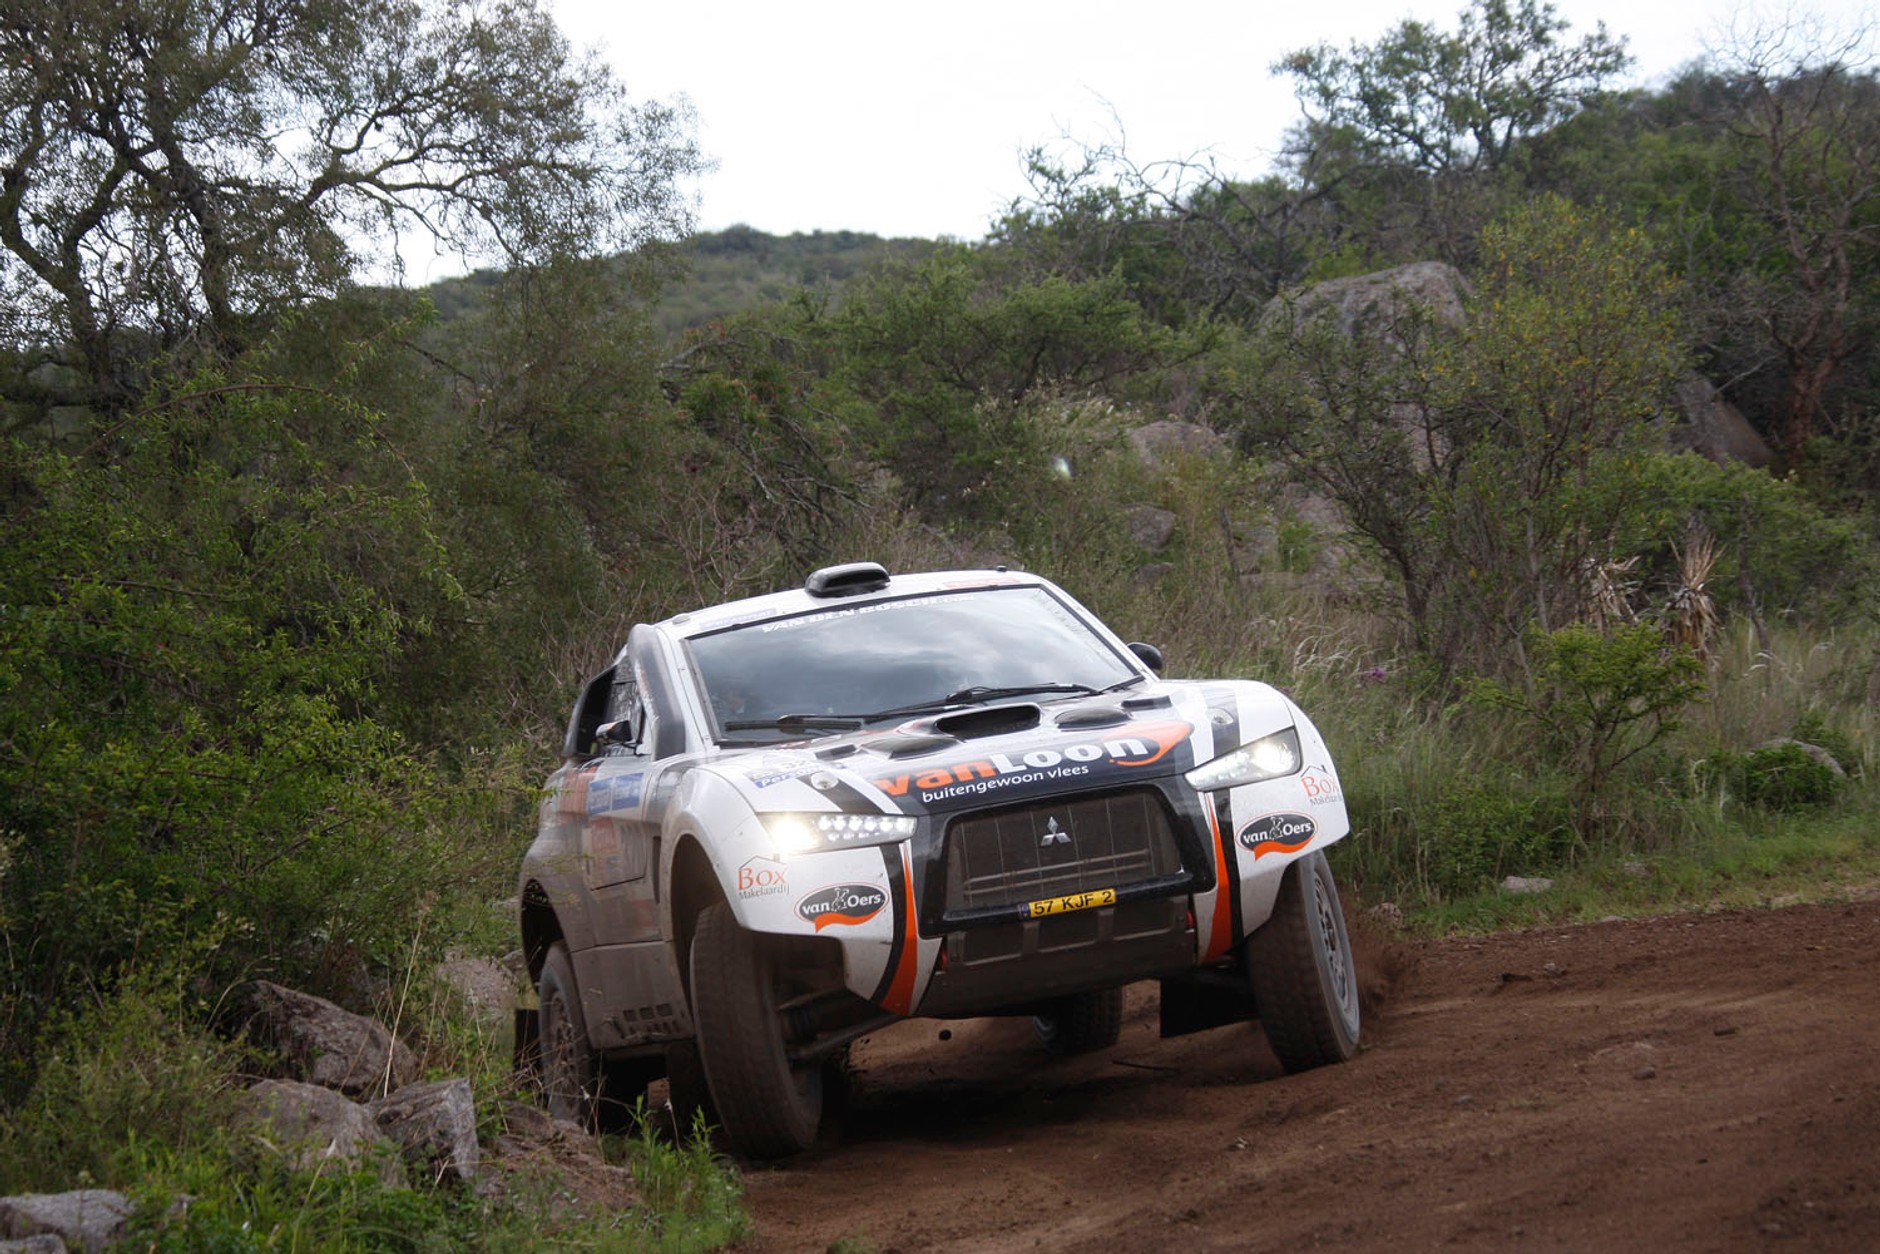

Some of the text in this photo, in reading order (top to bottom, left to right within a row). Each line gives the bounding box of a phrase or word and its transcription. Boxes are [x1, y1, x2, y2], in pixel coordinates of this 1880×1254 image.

[922, 764, 1089, 803] buitengewoon vlees
[1243, 823, 1312, 844] van Oers
[802, 893, 881, 915] van Oers
[1034, 890, 1113, 915] 57 KJF 2
